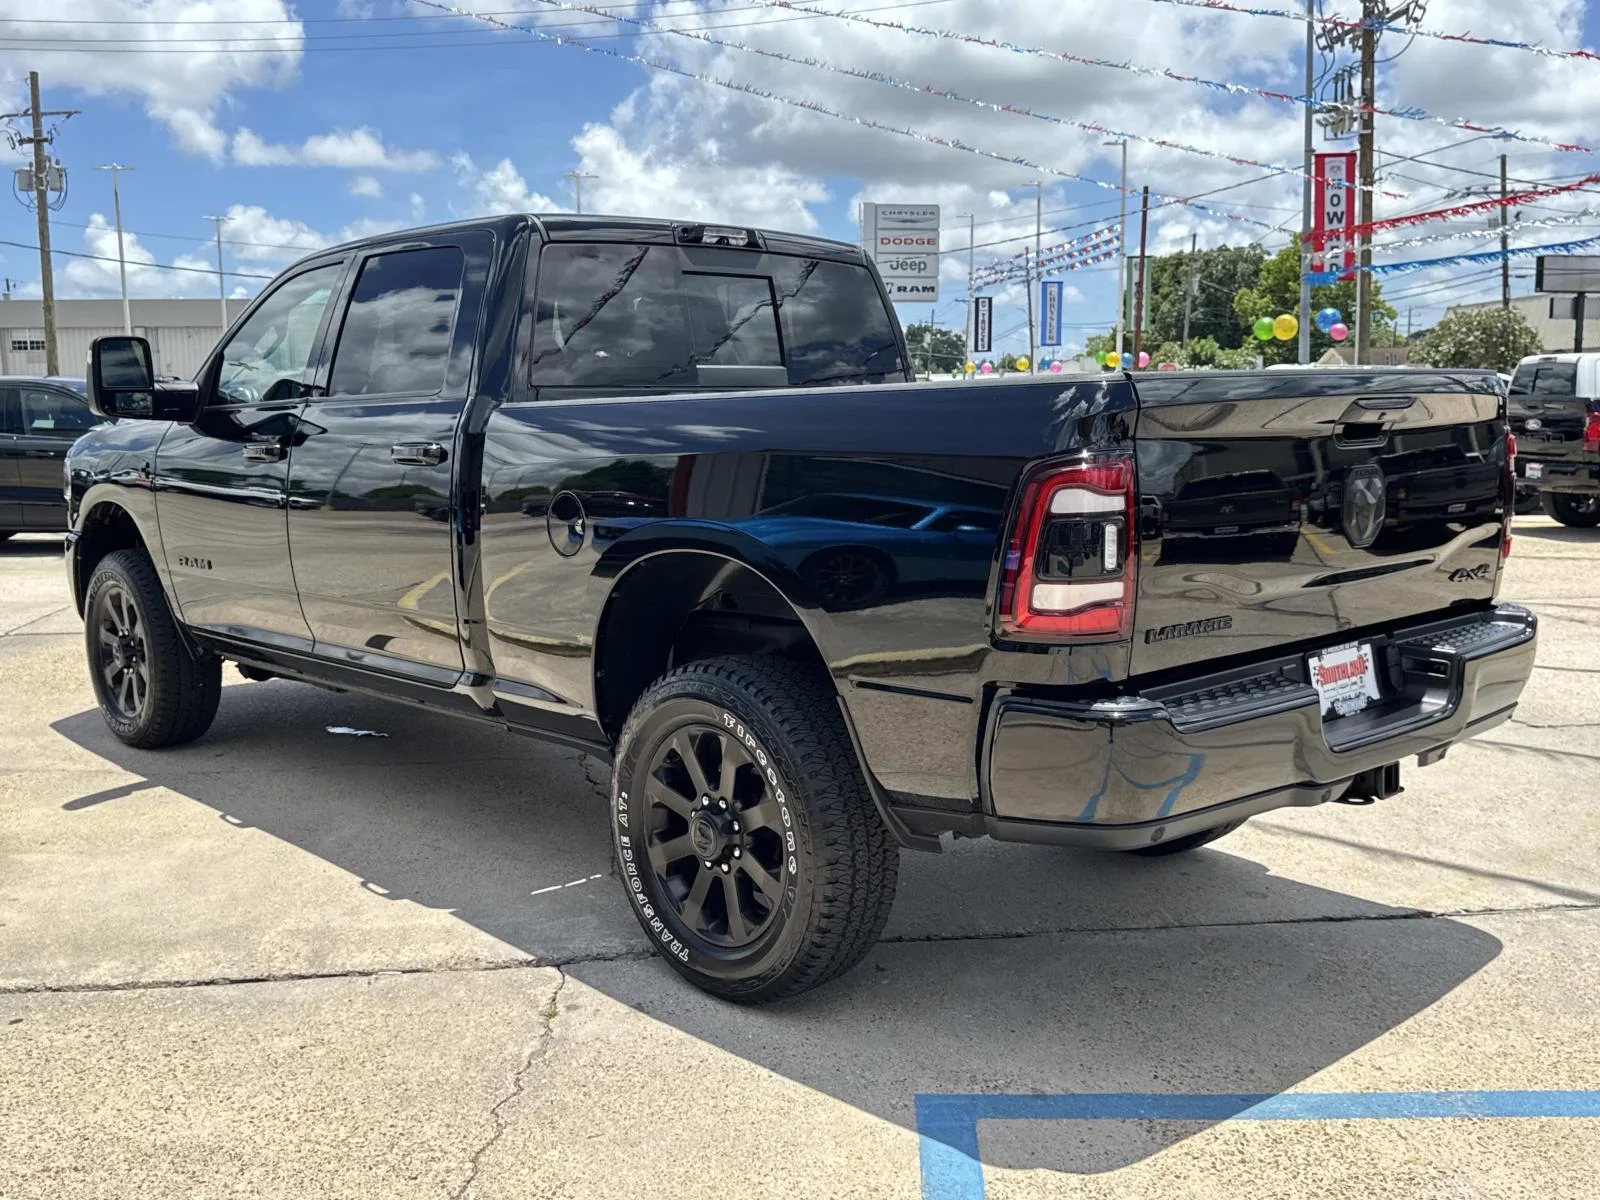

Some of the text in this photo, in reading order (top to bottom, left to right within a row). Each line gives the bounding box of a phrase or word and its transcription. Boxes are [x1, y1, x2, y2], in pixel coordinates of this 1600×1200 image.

[880, 237, 936, 246] DODGE
[889, 257, 927, 273] Jeep
[897, 285, 936, 293] RAM
[1144, 615, 1232, 644] LARAMIE
[620, 835, 689, 962] TRANSFORCE
